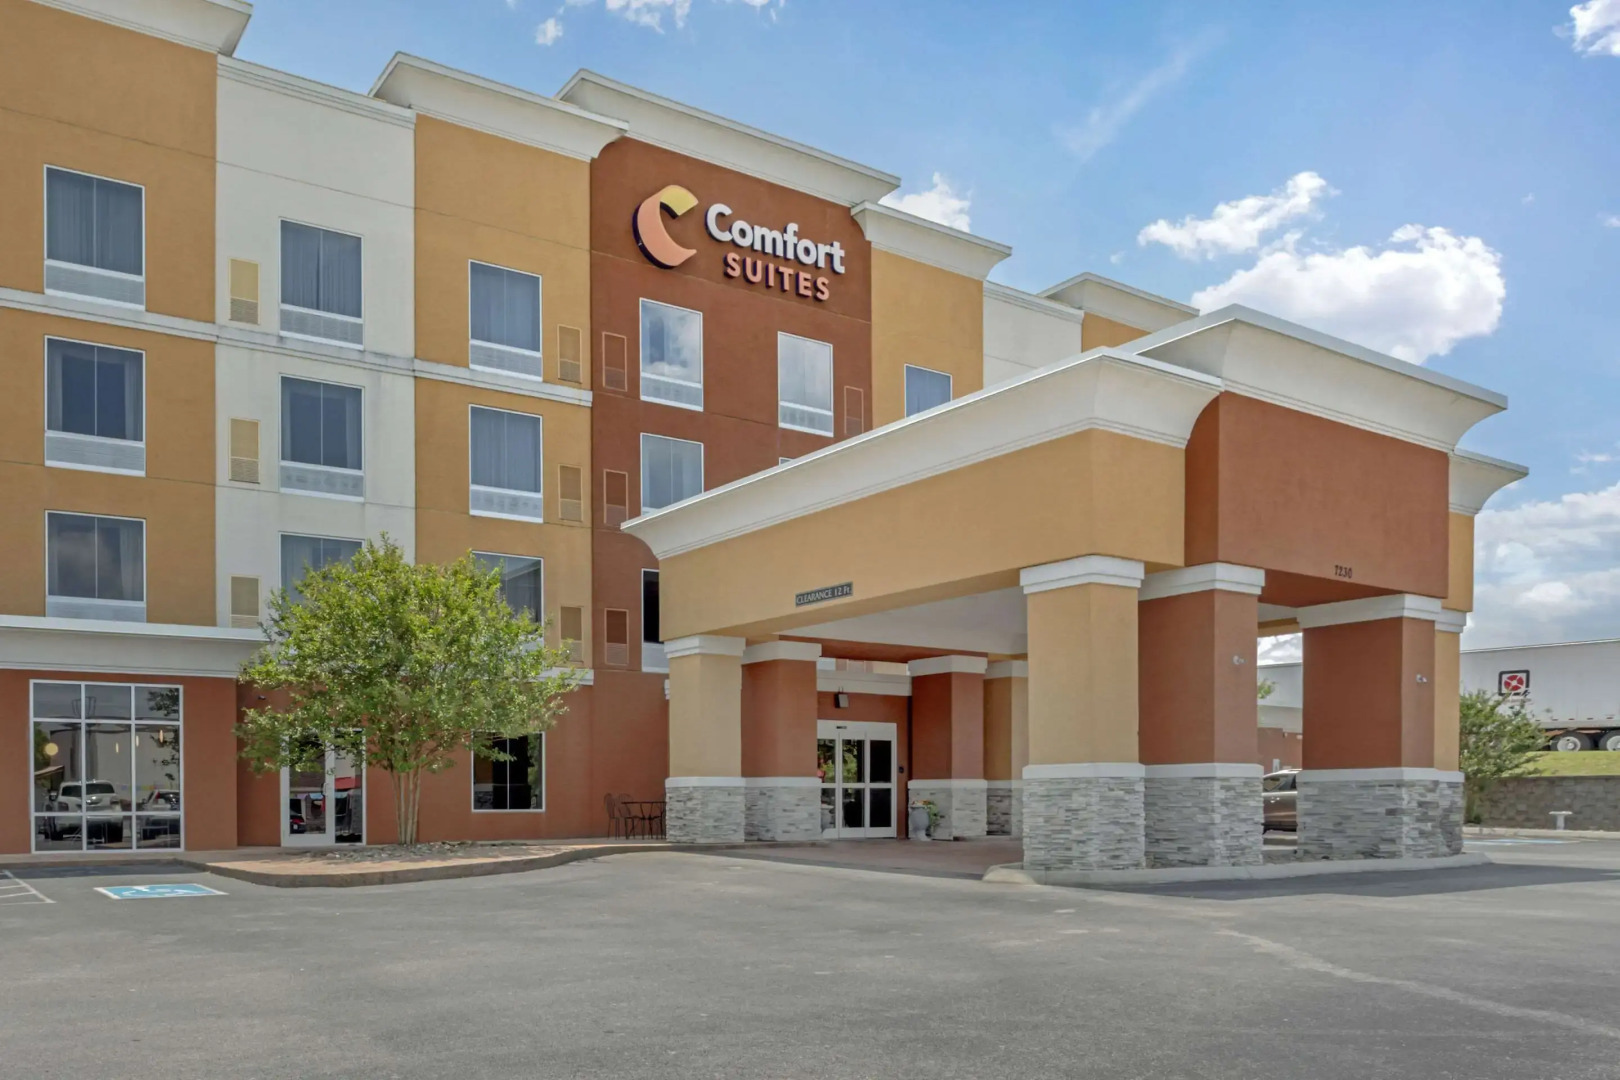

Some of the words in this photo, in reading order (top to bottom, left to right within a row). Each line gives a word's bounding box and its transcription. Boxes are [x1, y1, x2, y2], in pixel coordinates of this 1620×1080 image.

[705, 203, 845, 274] Comfort
[724, 252, 830, 301] SUITES
[796, 589, 833, 604] CLEARANCE
[834, 587, 842, 596] 12
